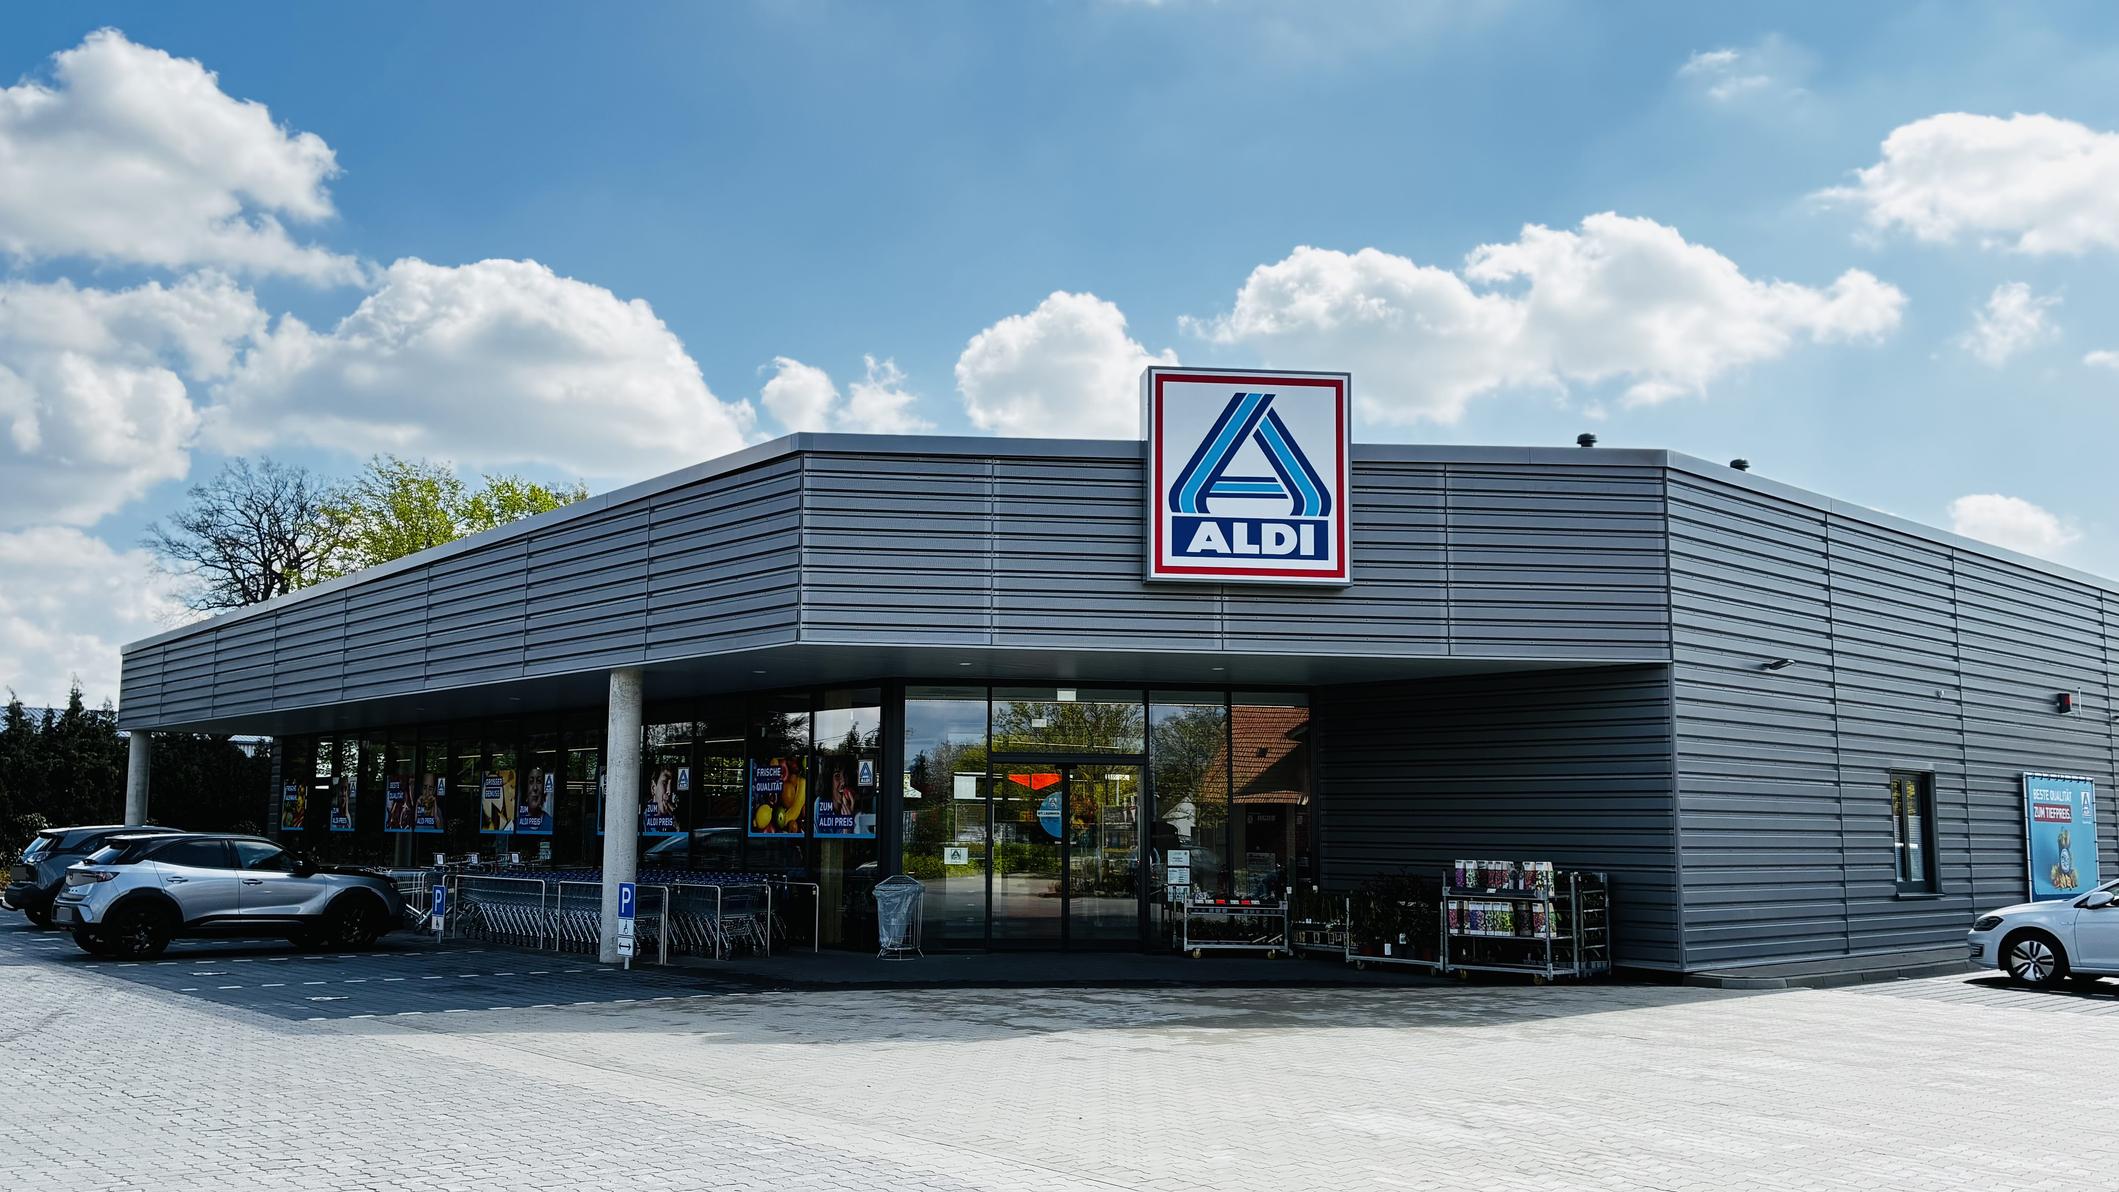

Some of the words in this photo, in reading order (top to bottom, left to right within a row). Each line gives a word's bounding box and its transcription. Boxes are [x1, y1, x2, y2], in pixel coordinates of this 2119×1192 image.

[1186, 521, 1315, 556] ALDI
[757, 767, 782, 777] FRISCHE
[485, 777, 503, 786] GROSSER
[756, 781, 783, 792] QUALITÄT
[485, 789, 500, 797] GENUSS
[2033, 788, 2049, 800] BESTE
[2050, 788, 2072, 802] QUALITÄT
[519, 805, 529, 813] ZUM
[647, 804, 658, 813] ZUM
[819, 802, 833, 811] ZUM
[2034, 806, 2045, 818] ZUM
[519, 817, 528, 826] ALDI
[529, 817, 541, 826] PREIS
[646, 817, 658, 826] ALDI
[659, 817, 673, 826] PREIS
[818, 817, 834, 827] ALDI
[835, 817, 854, 827] PREIS
[435, 889, 443, 912] P
[621, 887, 632, 914] P
